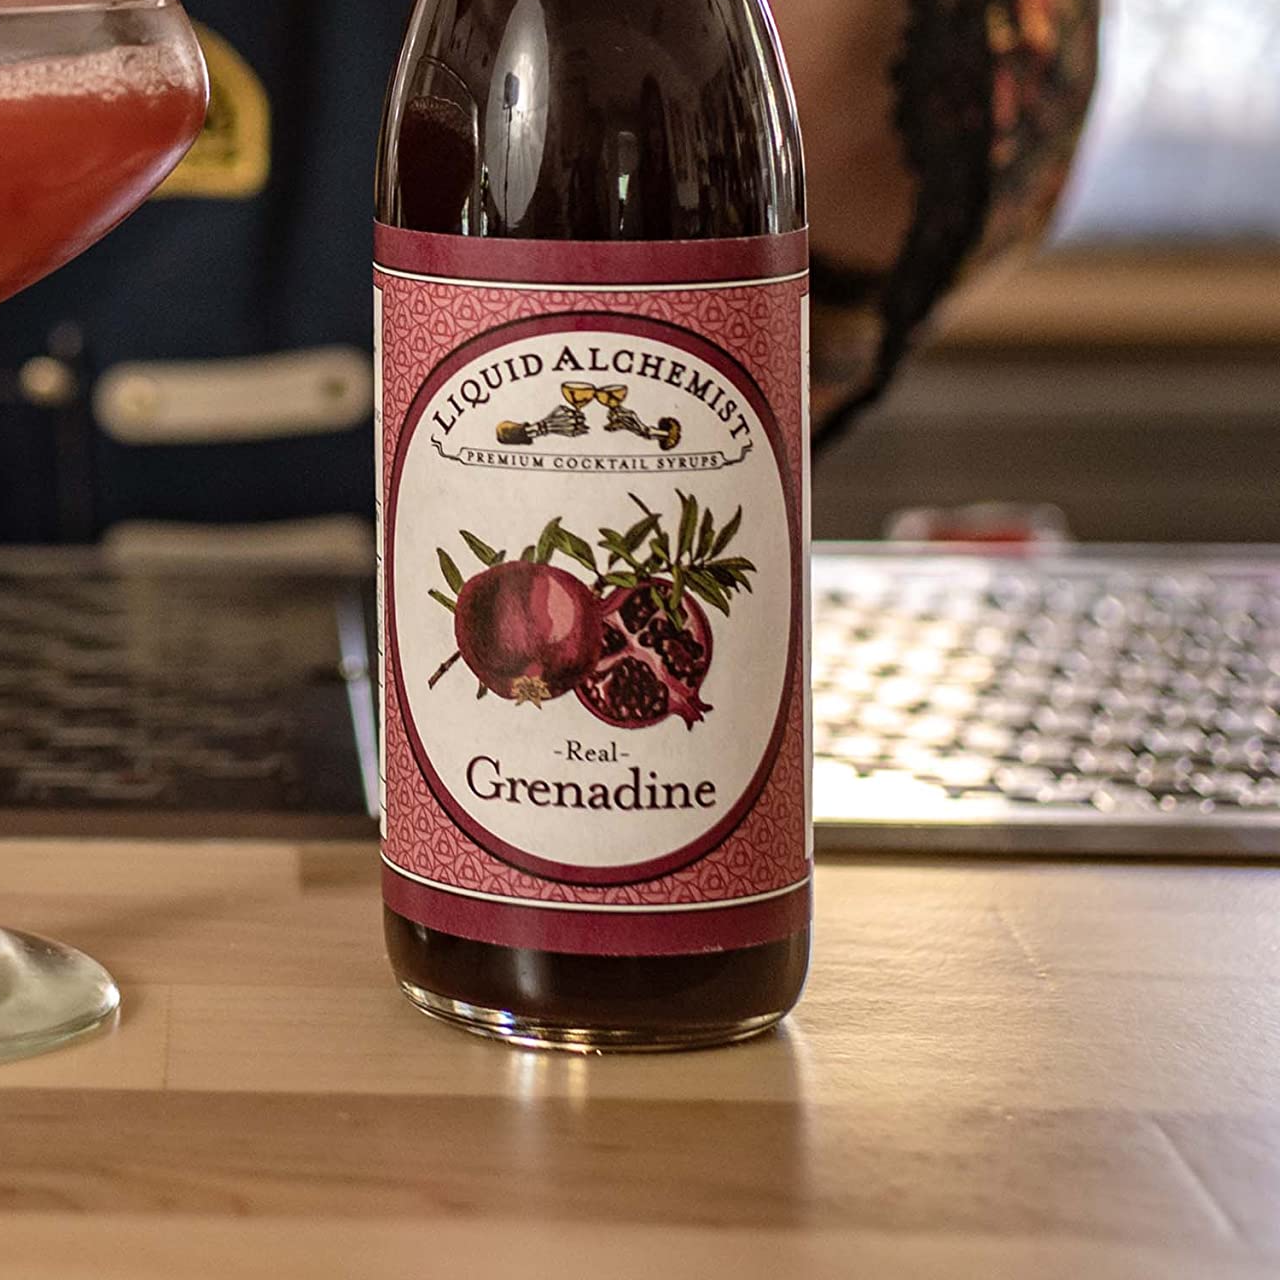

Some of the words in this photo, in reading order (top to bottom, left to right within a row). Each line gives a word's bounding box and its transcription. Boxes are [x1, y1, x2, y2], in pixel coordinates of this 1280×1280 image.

[432, 352, 544, 436] LIQUID
[551, 345, 750, 440] ALCHEMIST
[466, 451, 544, 468] PREMIUM
[553, 457, 648, 470] COCKTAIL
[657, 455, 719, 470] SYRUPS
[466, 755, 717, 811] Grenadine
